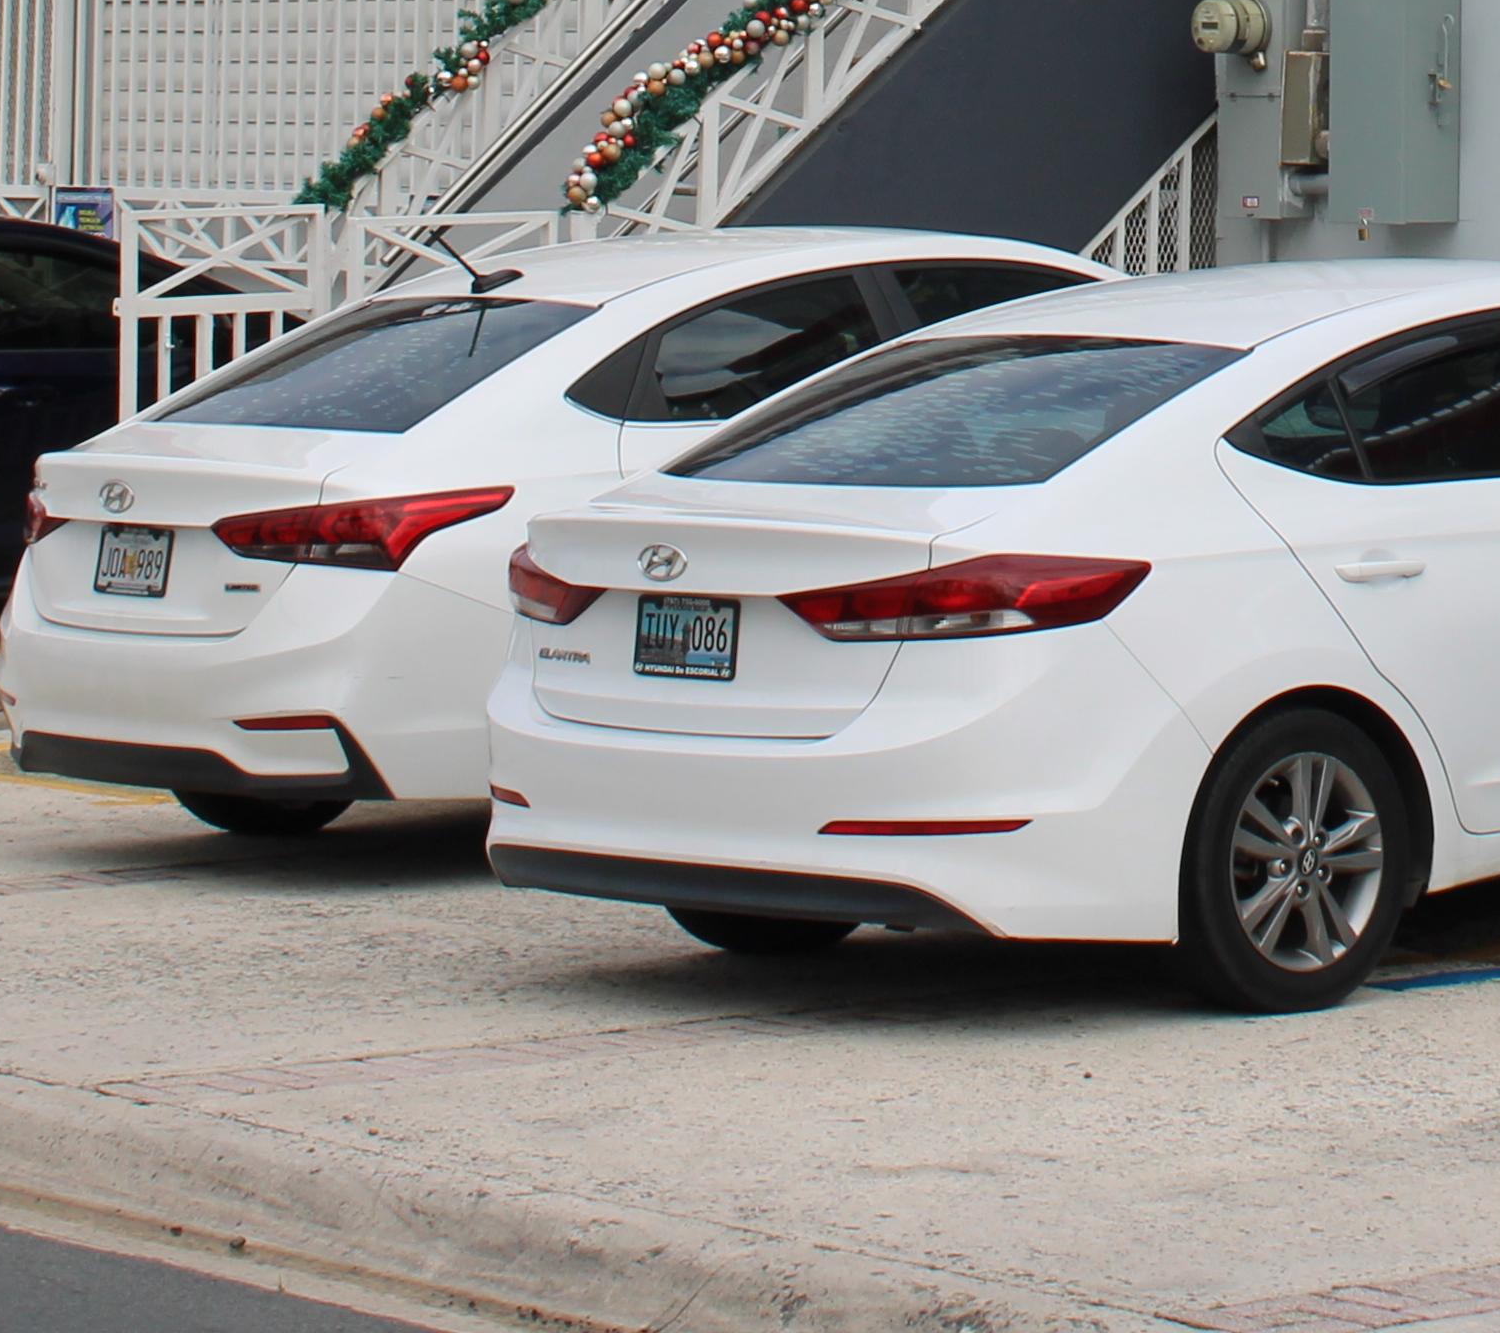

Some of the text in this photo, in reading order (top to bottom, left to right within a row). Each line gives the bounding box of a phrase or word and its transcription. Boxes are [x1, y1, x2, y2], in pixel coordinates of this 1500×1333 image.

[137, 549, 164, 580] 989
[643, 612, 728, 652] IUY 086
